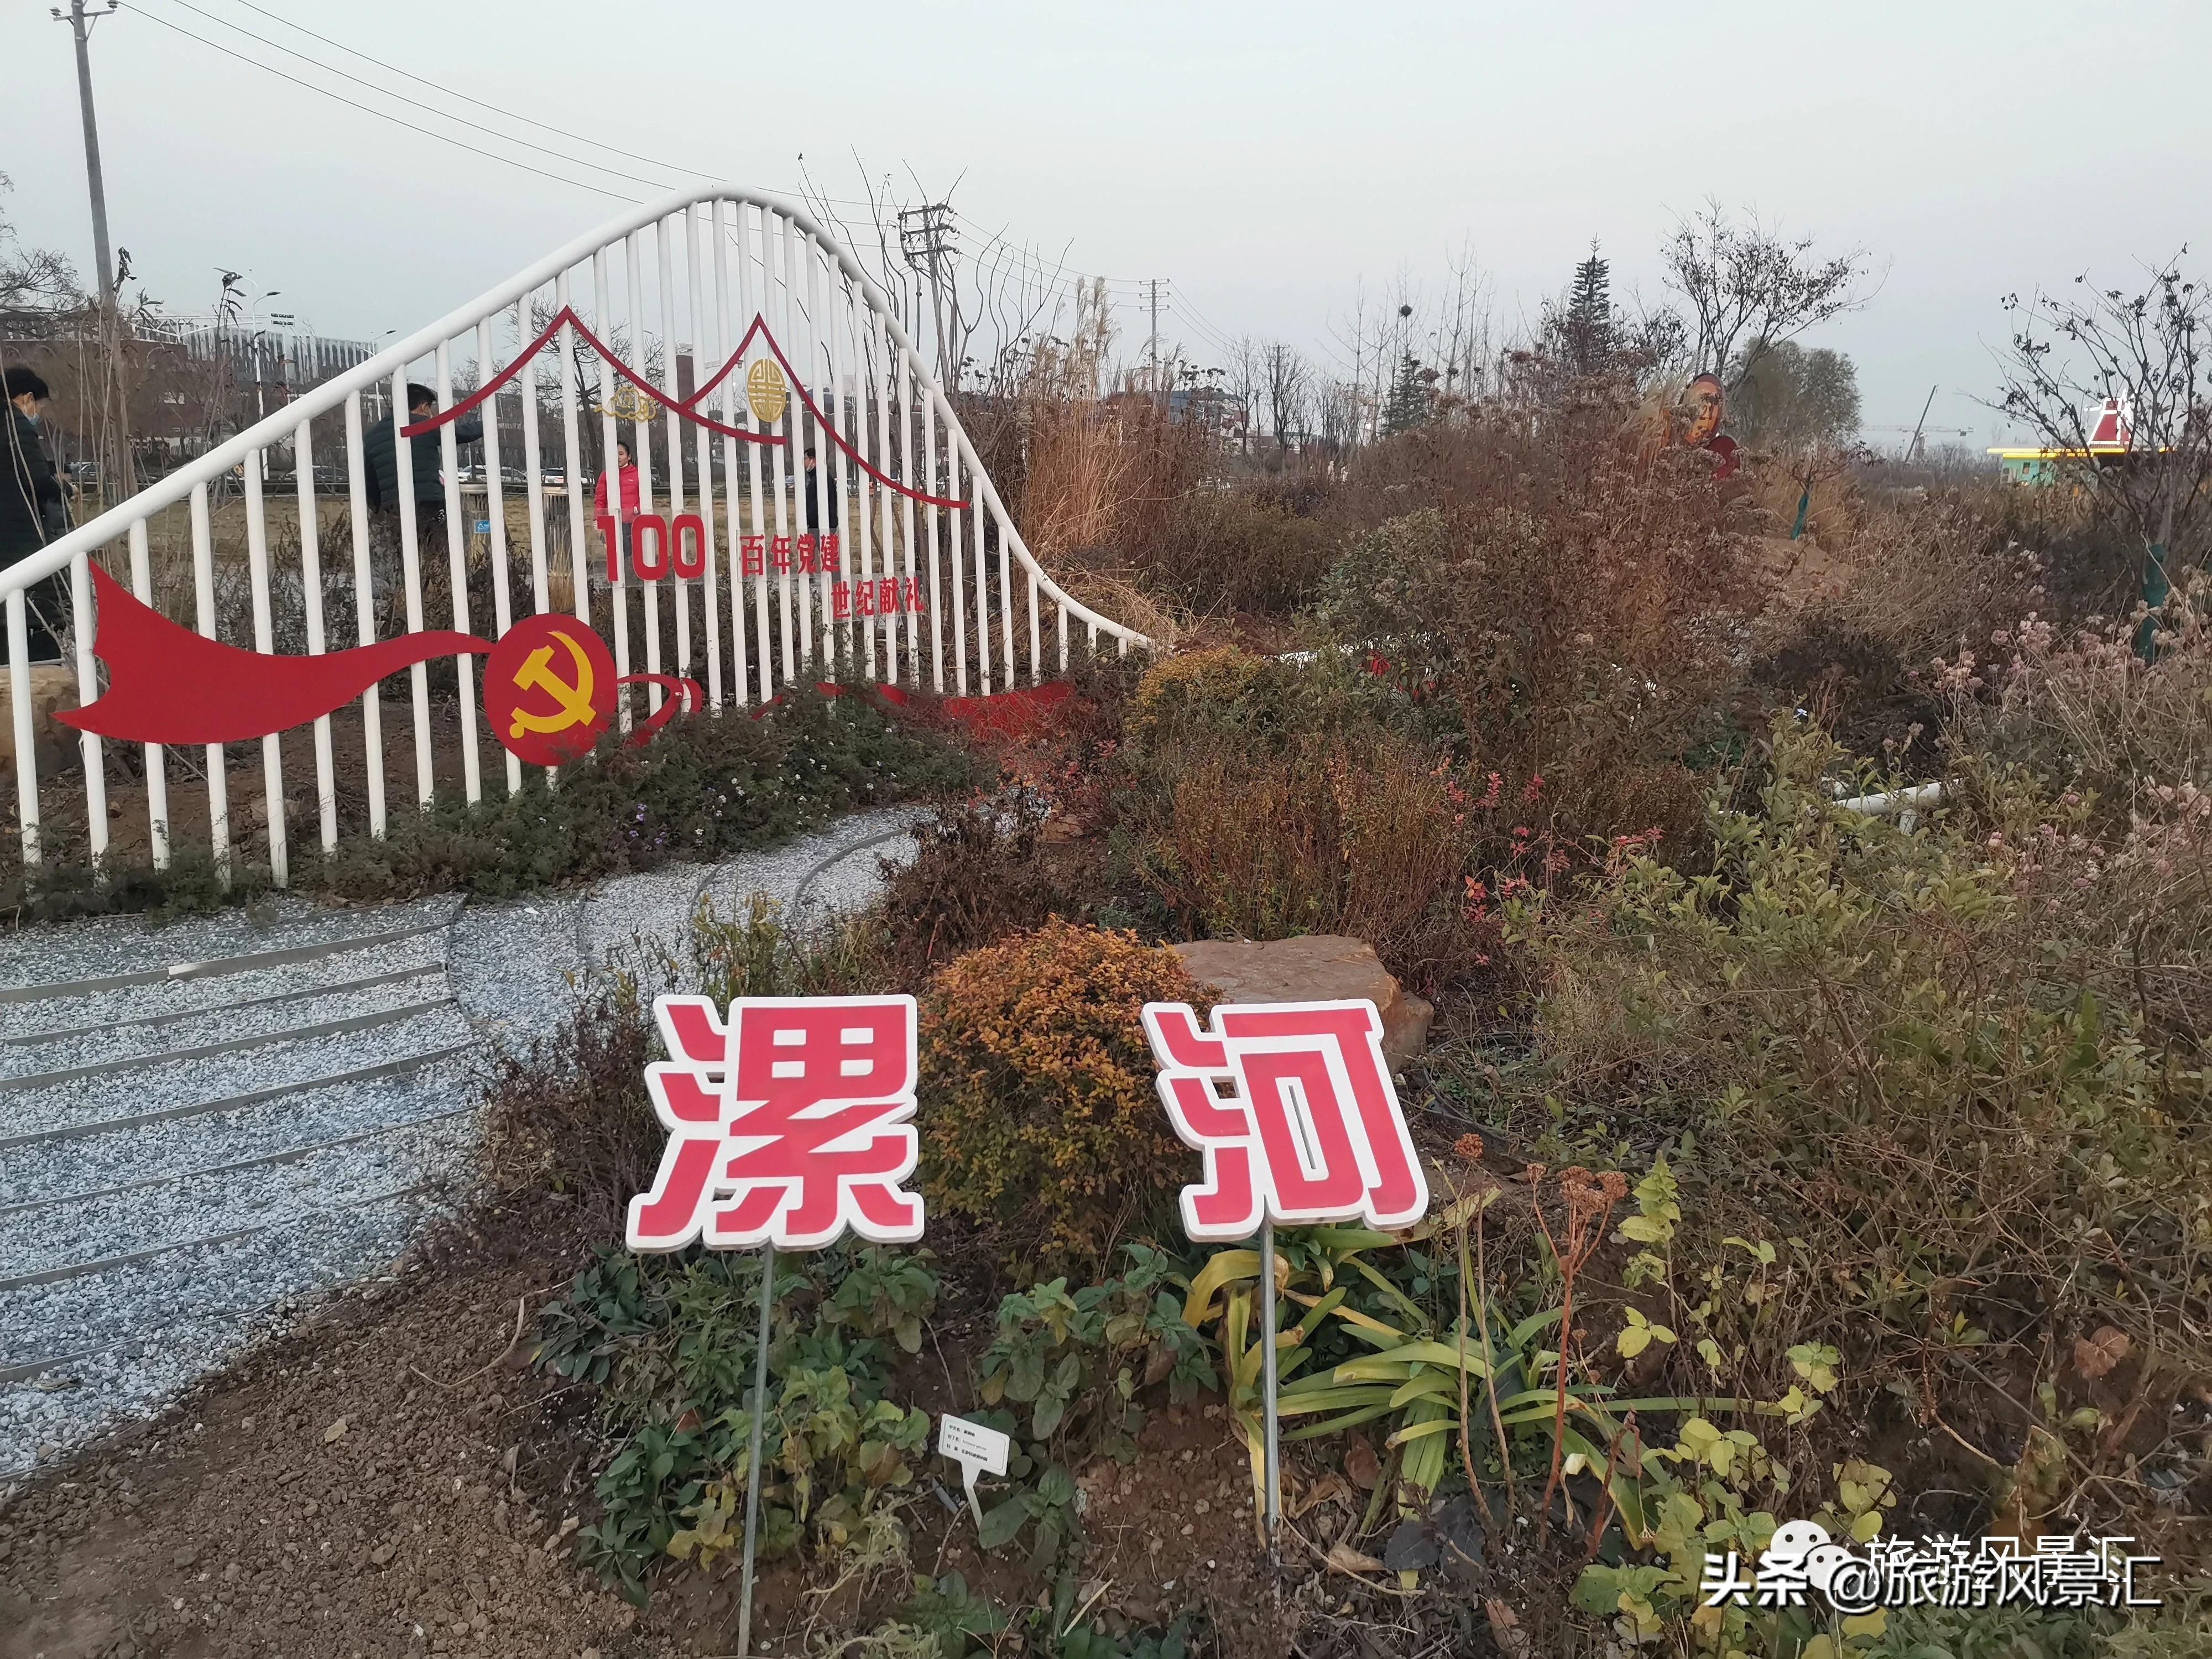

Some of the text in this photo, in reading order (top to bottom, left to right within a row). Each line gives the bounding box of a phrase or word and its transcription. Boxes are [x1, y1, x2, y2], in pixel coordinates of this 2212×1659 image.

[597, 514, 706, 582] 100
[739, 533, 841, 577] 百年党建
[831, 576, 926, 619] 世纪献礼
[633, 1000, 918, 1241] 漯
[1149, 1002, 1421, 1230] 河
